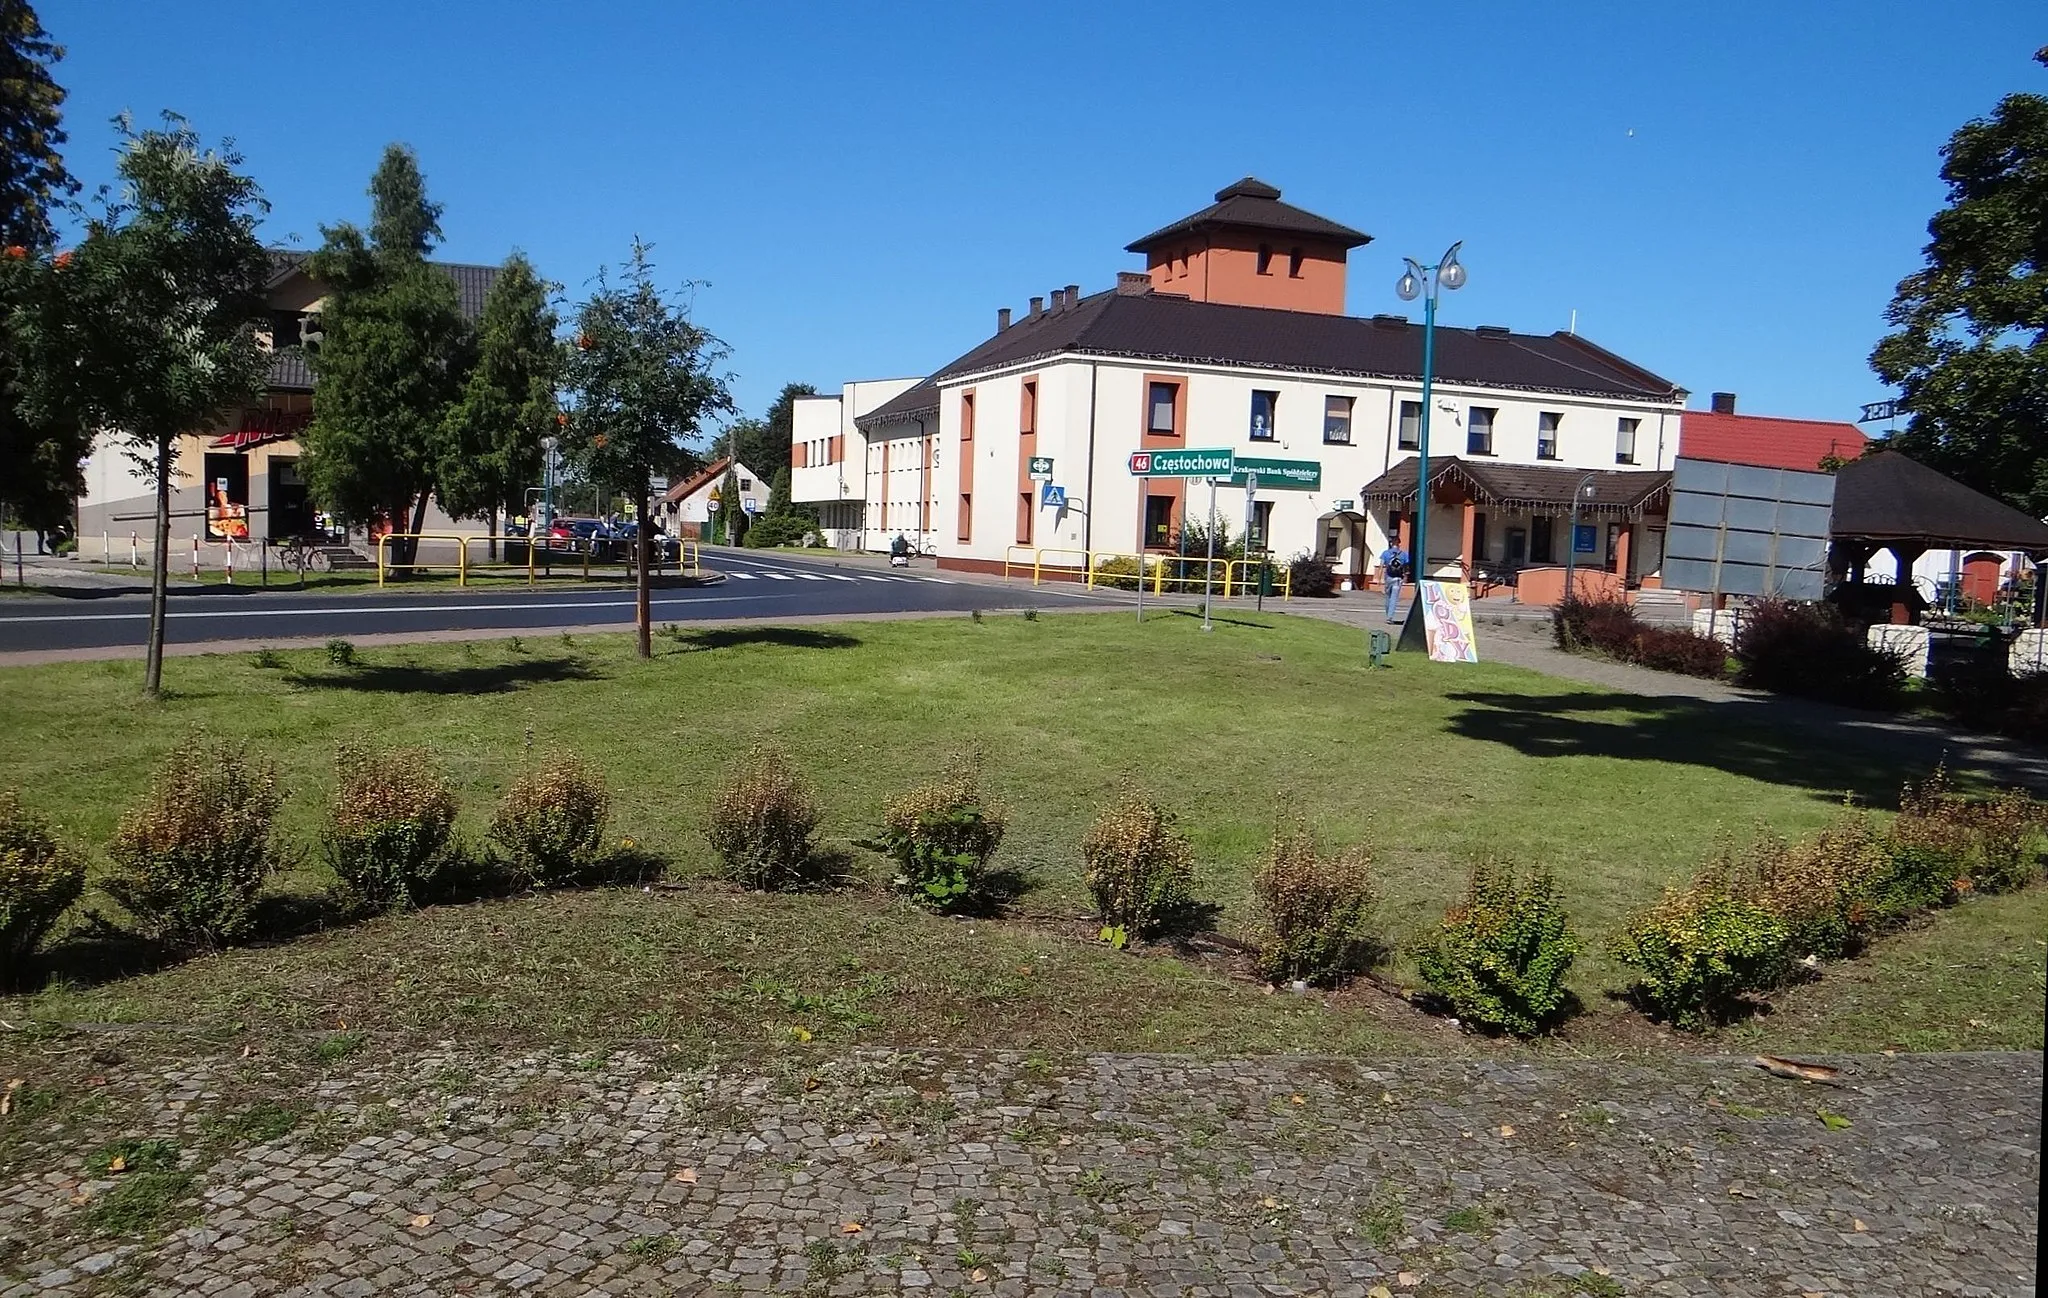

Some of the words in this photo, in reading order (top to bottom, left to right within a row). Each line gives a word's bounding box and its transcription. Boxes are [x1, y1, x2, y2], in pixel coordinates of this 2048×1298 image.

[1135, 457, 1147, 470] 46
[1154, 454, 1230, 474] Częstochowa
[1266, 467, 1282, 475] Bank
[1424, 583, 1471, 660] LODY
